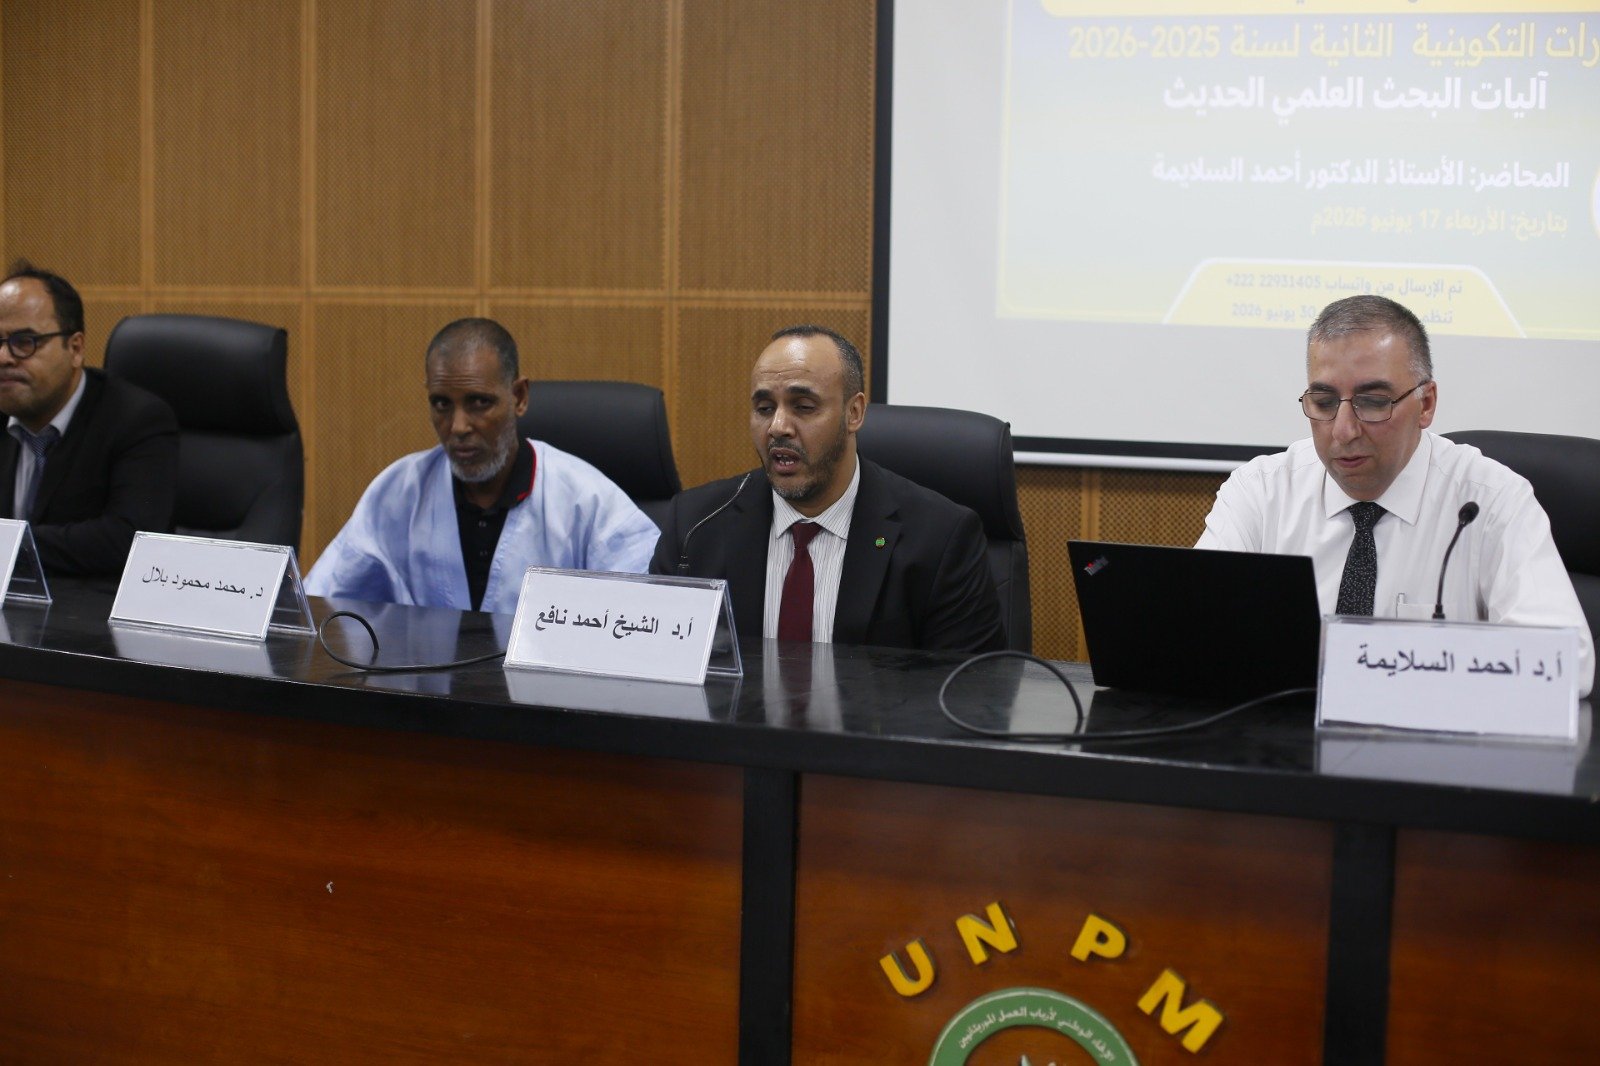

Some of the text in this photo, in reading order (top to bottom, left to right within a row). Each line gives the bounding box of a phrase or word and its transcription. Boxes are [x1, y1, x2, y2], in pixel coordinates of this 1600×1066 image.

[1230, 22, 1301, 58] لسنة
[1310, 22, 1393, 67] الثانية
[1412, 22, 1535, 67] التكوينية
[1162, 71, 1550, 127] آليات البحث العلمي الحديث
[1152, 147, 1570, 192] المحاضر: الأستاذ الدكتور أحمد السلايمة
[1370, 208, 1413, 233] يونيو
[1419, 207, 1440, 229] 17
[1445, 206, 1505, 236] الأربعاء
[1325, 276, 1372, 294] واتساب
[1376, 282, 1394, 294] من
[142, 566, 169, 587] بلال
[172, 573, 210, 590] محمود
[214, 578, 246, 595] محمد
[535, 605, 568, 631] نافع
[572, 609, 609, 629] أحمد
[612, 614, 659, 639] الشيخ
[1357, 643, 1455, 677] السلايمة
[1467, 649, 1520, 676] أحمد
[998, 1006, 1027, 1022] العمل
